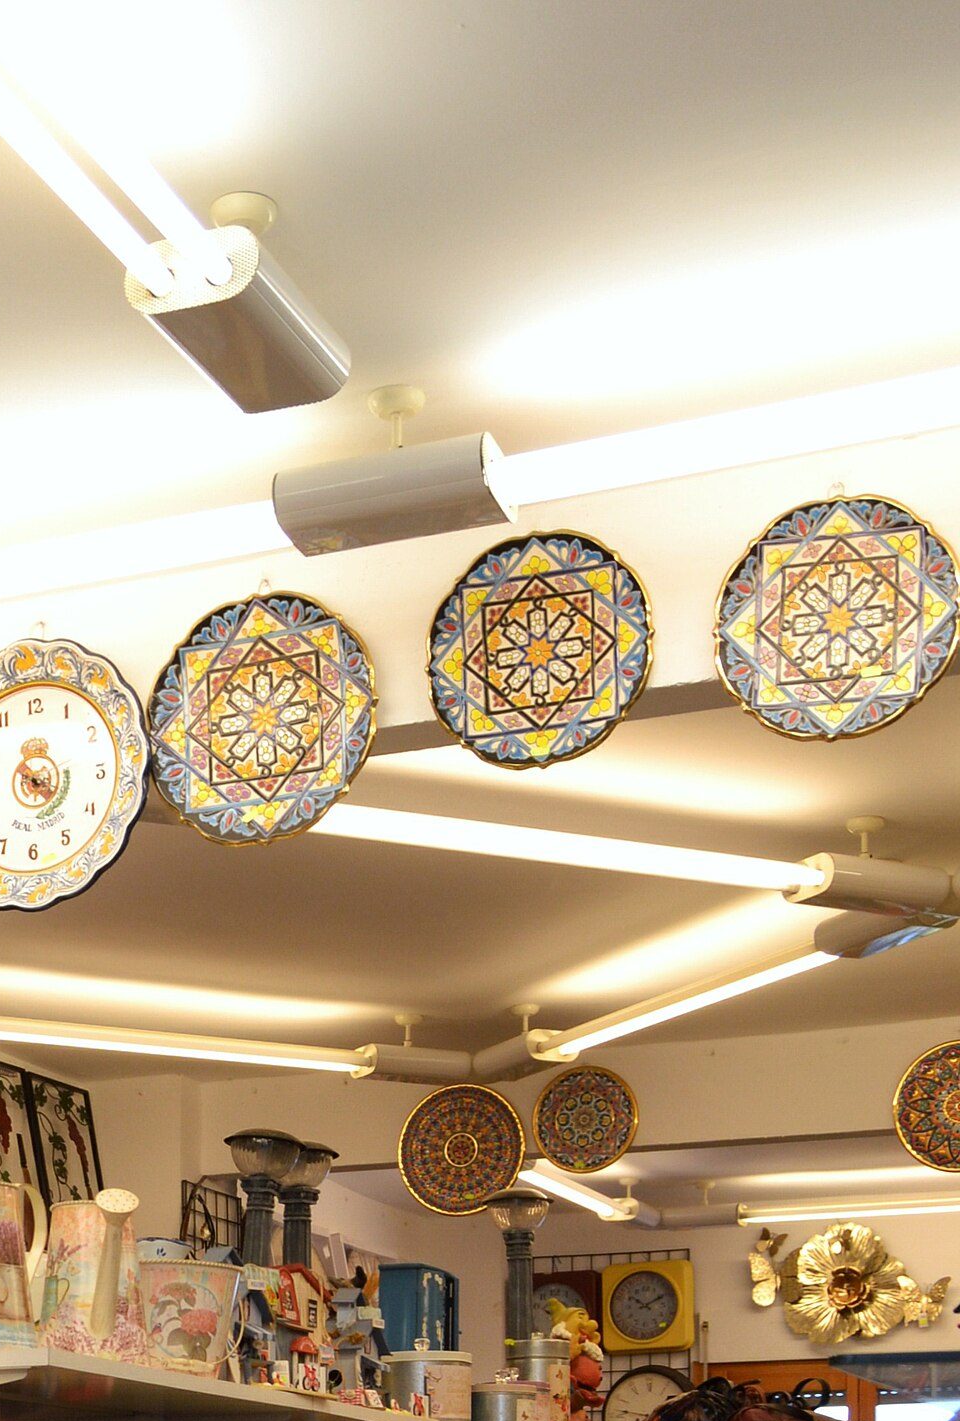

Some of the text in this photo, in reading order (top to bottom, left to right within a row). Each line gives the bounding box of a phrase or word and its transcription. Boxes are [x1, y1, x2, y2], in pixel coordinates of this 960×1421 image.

[28, 699, 44, 714] 12
[63, 703, 69, 719] 1
[87, 726, 97, 743] 2
[96, 764, 106, 779] 3
[85, 801, 95, 815] 4
[11, 812, 65, 832] REAL MADRID
[61, 830, 70, 845] 5
[29, 844, 38, 860] 6
